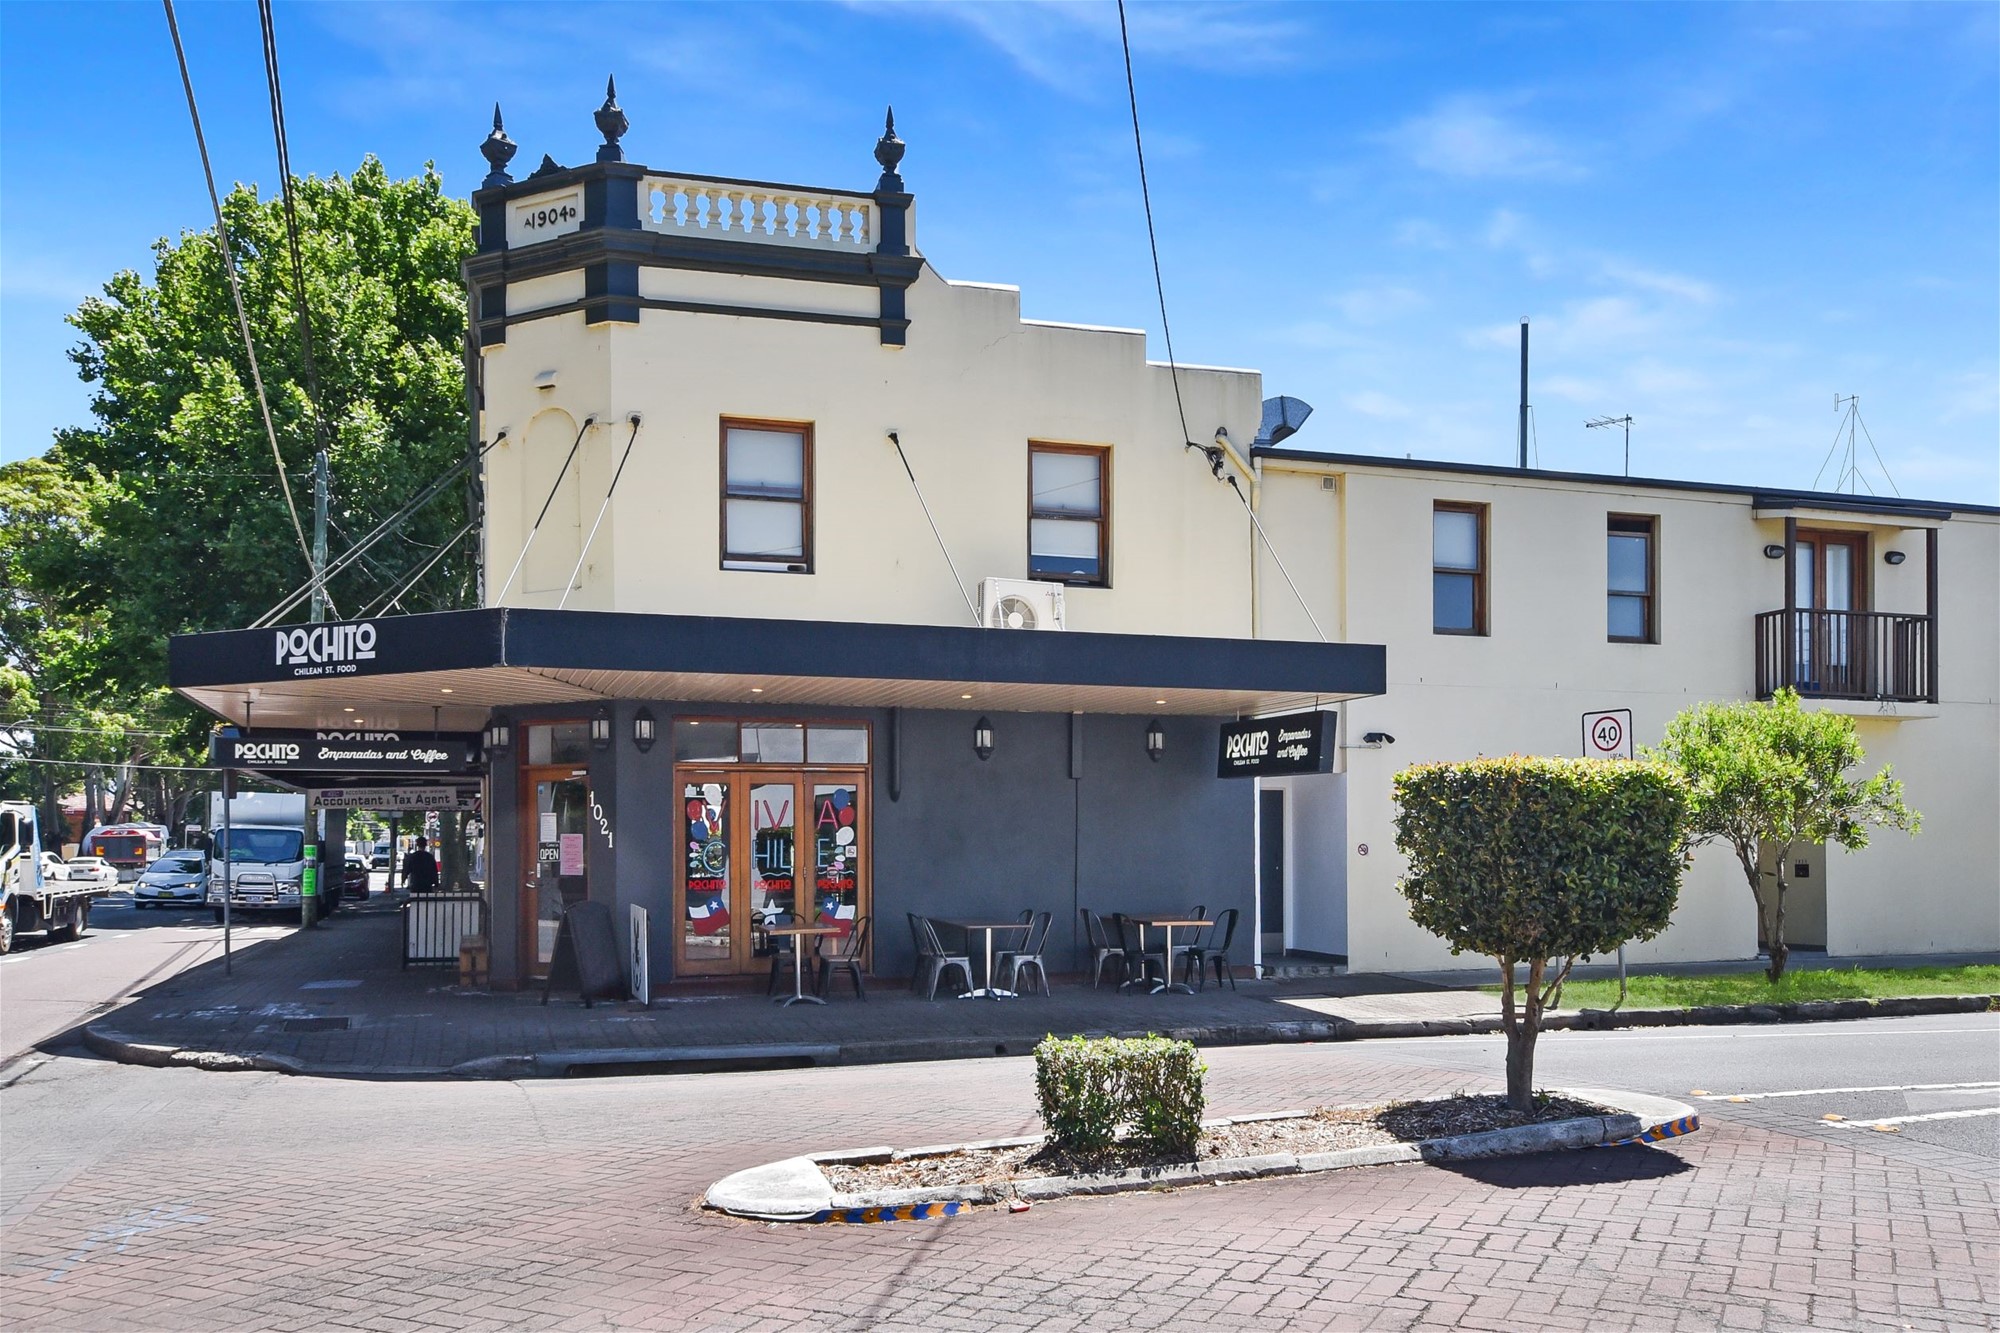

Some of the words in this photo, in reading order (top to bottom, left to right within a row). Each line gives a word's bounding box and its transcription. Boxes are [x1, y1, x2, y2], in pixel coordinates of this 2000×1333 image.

[276, 623, 376, 665] POCHITO
[294, 667, 322, 676] CHILEAN
[325, 666, 334, 674] ST.
[337, 664, 357, 673] FOOD
[1278, 728, 1312, 743] Empanadas
[1597, 726, 1617, 742] 40
[235, 743, 300, 759] POCHITO
[1226, 730, 1269, 758] POCHITO
[318, 747, 384, 761] Empanadas
[386, 749, 408, 760] and
[411, 749, 448, 763] Coffee
[1288, 744, 1308, 761] Coffee
[313, 796, 383, 807] Accountant
[392, 794, 412, 805] Tax
[416, 793, 450, 806] Agent
[590, 791, 613, 848] 1021
[540, 848, 559, 860] OPEN
[688, 879, 727, 890] POCHITO
[754, 879, 792, 890] POCHITO
[817, 879, 854, 890] POCHITO
